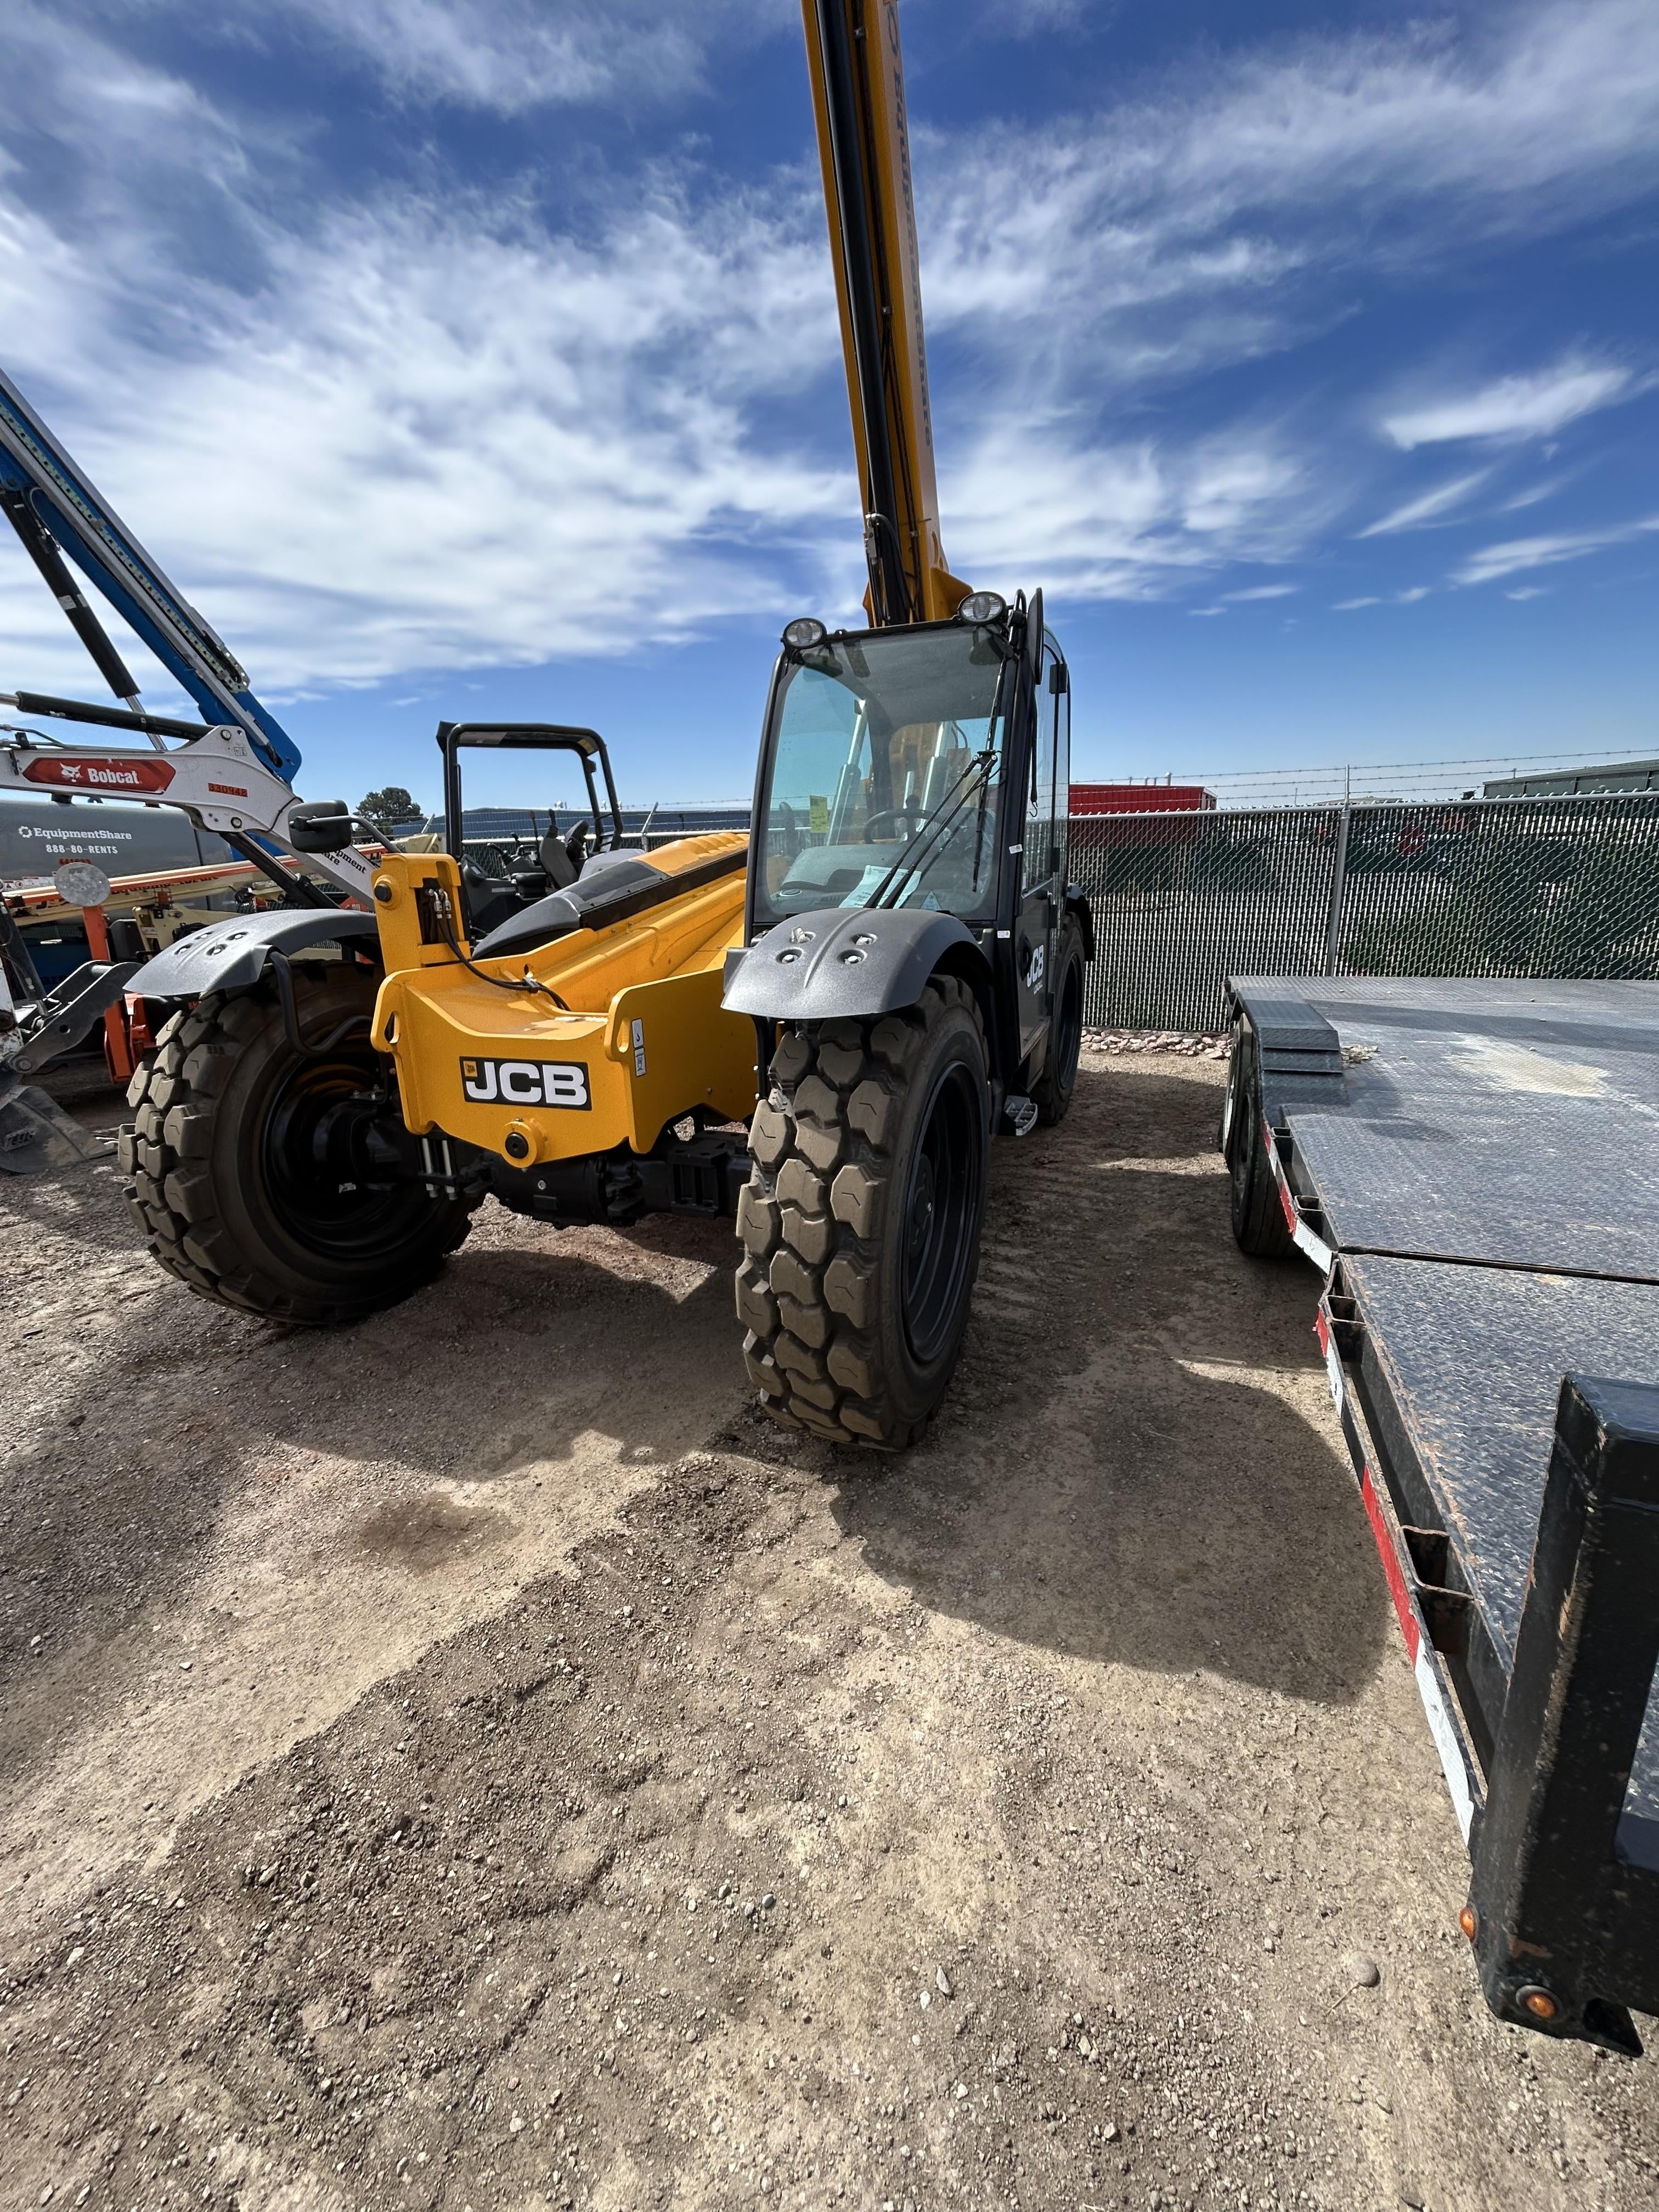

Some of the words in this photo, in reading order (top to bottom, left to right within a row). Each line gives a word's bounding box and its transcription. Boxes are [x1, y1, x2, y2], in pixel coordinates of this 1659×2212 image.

[893, 65, 931, 447] EquipmentShare
[88, 768, 139, 784] Bobcat
[33, 827, 132, 839] EquipmentShare
[46, 844, 119, 854] 888-80-RENTS
[335, 850, 367, 874] pment
[1026, 944, 1044, 988] JCB
[466, 1062, 587, 1105] JCB
